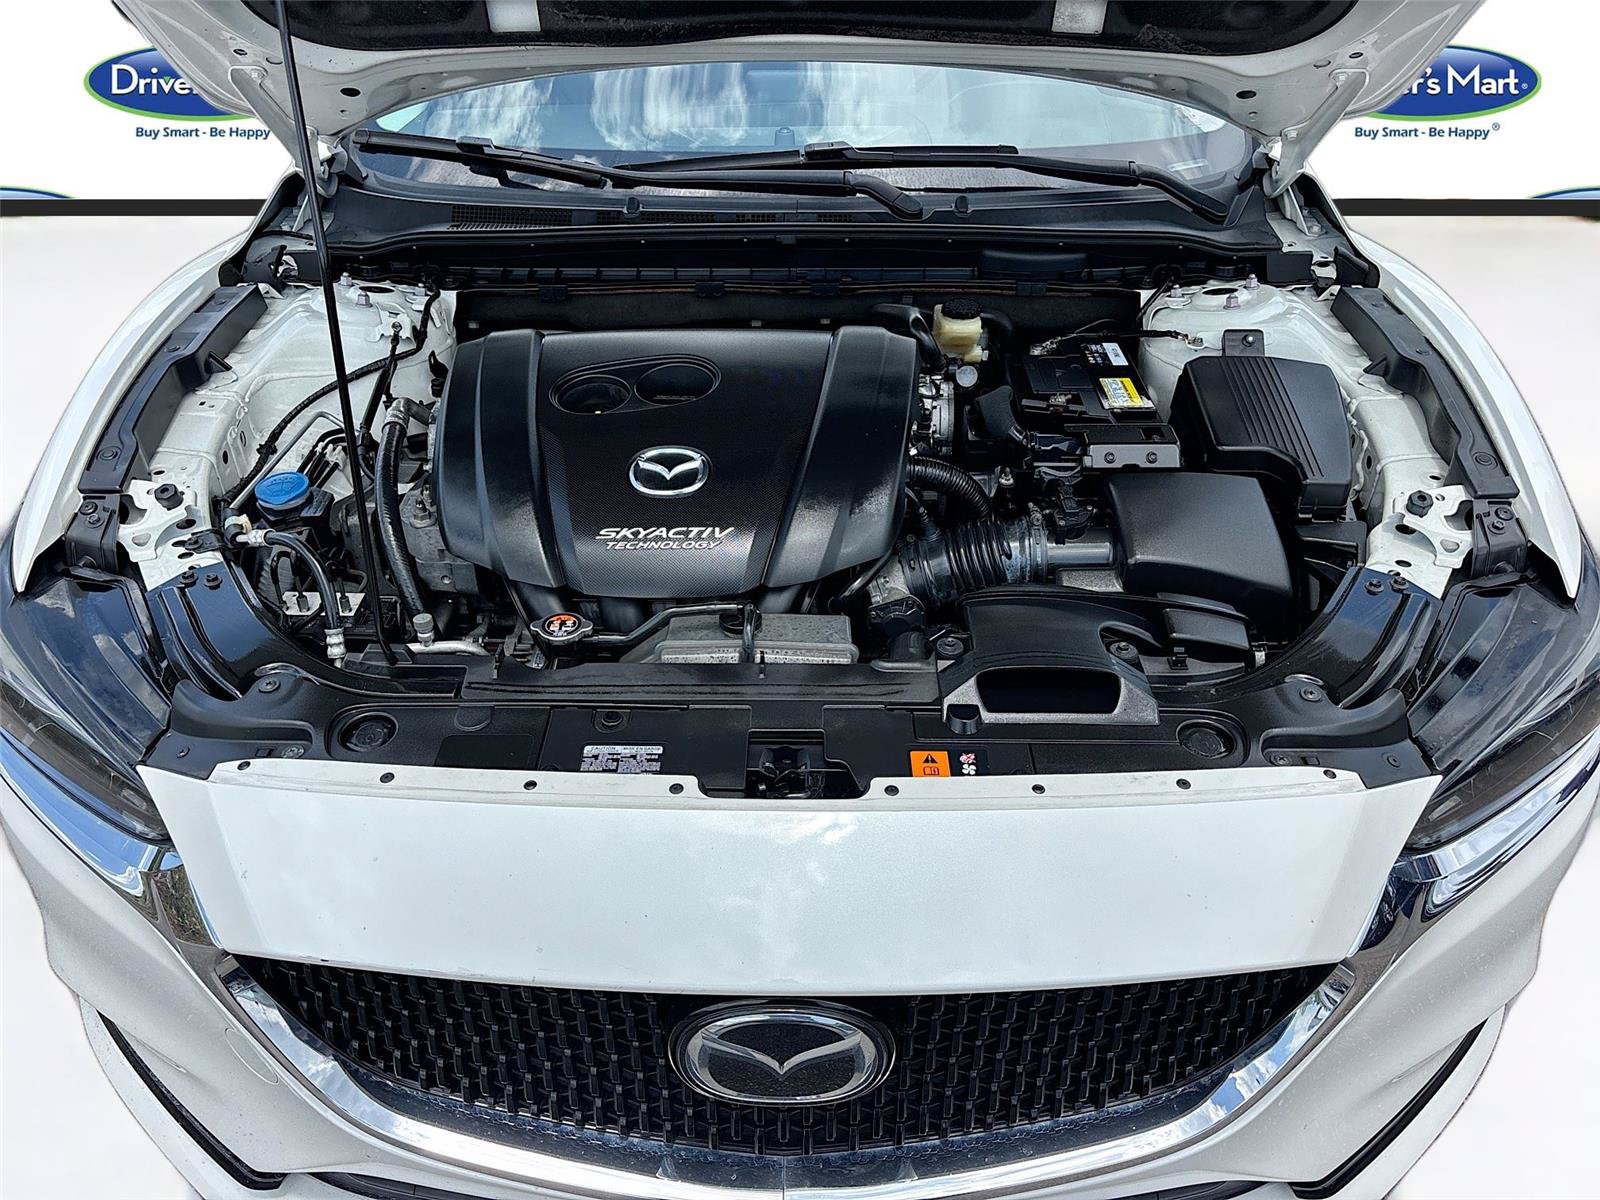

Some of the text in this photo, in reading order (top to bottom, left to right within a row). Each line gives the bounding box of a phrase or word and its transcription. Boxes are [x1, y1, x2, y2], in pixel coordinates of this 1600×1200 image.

[111, 64, 199, 95] Drive
[135, 127, 160, 140] Buy
[163, 127, 200, 138] Smart
[209, 127, 226, 138] Be
[229, 127, 271, 140] Happy
[1355, 127, 1379, 140] Buy
[1382, 127, 1418, 138] Smart
[1428, 127, 1445, 138] Be
[595, 527, 735, 539] SKYACTIV
[606, 540, 721, 550] TECHNOLOGY
